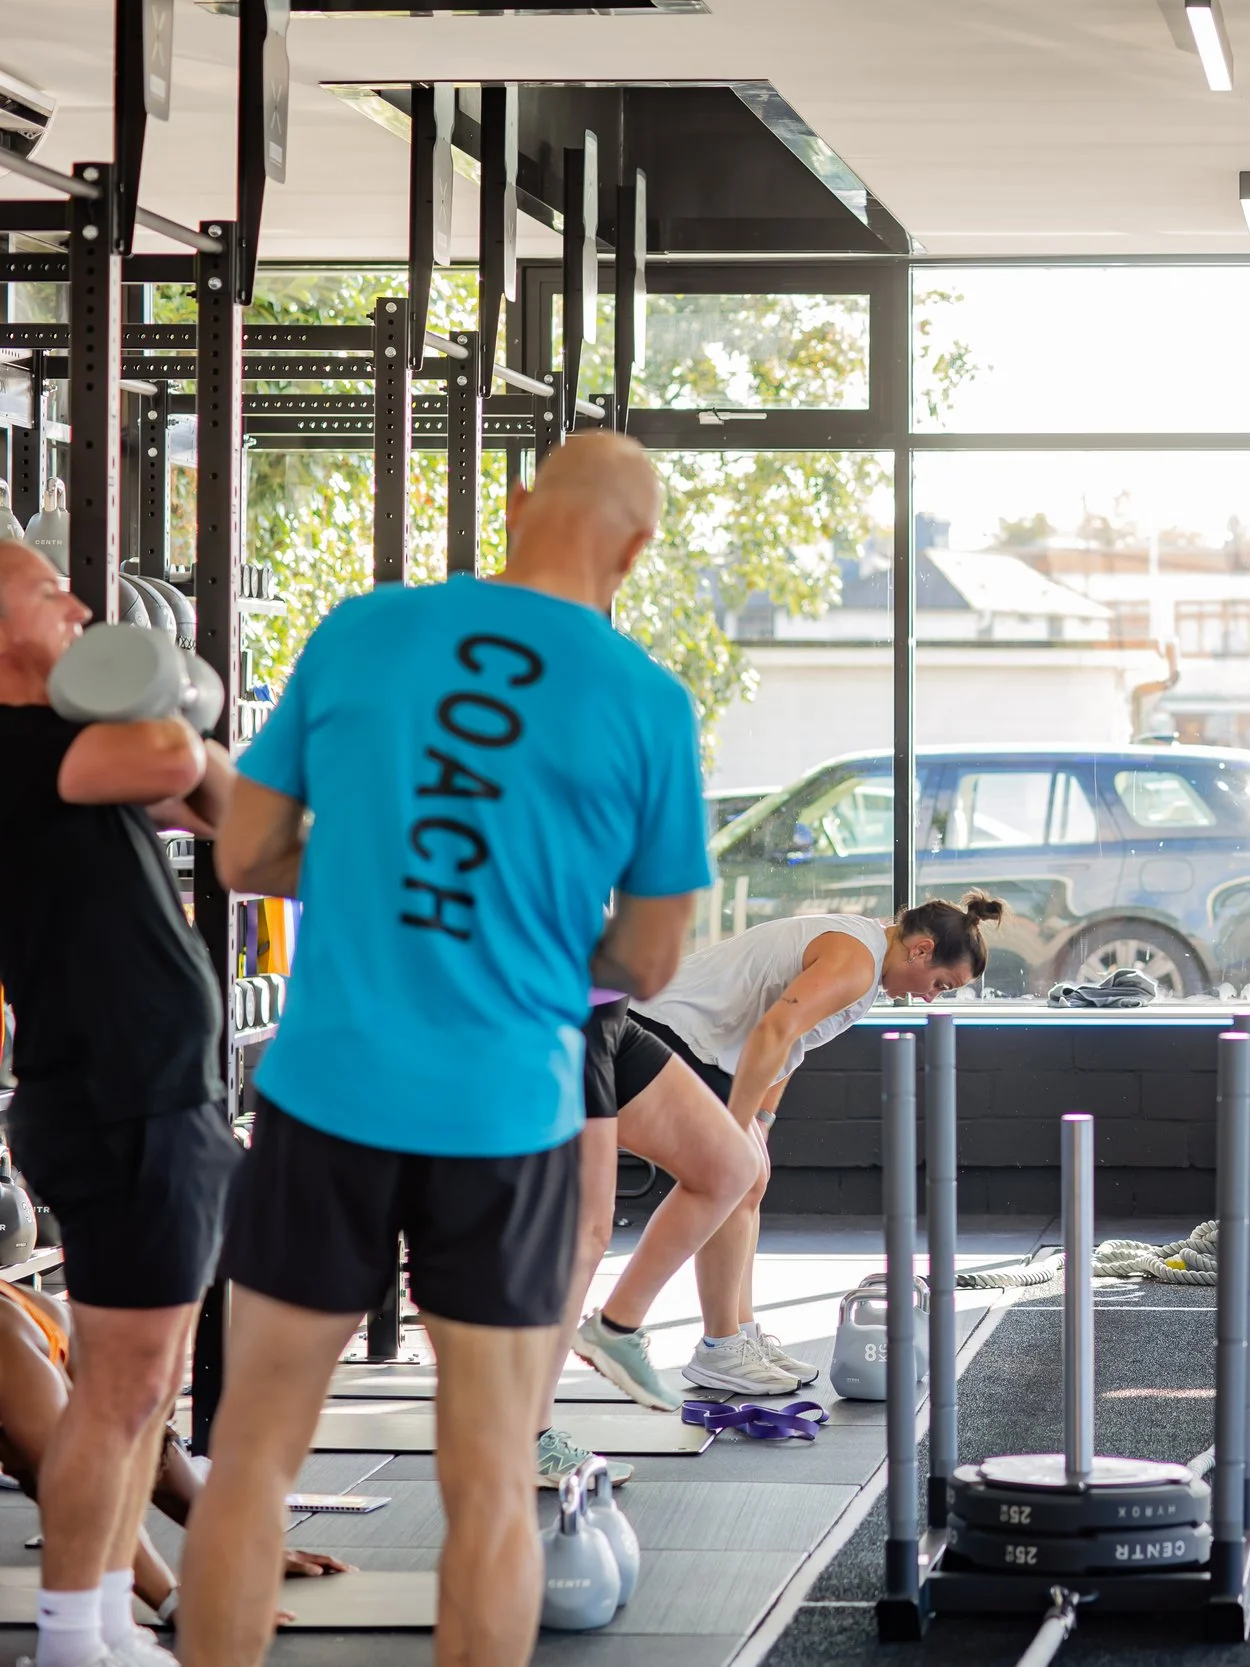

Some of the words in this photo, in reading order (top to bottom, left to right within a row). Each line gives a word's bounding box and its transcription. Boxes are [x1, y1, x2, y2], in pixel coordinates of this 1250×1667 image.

[399, 633, 545, 942] COACH
[864, 1343, 877, 1362] 8
[1009, 1505, 1032, 1525] 25
[1118, 1503, 1177, 1518] HYROX
[1014, 1546, 1038, 1565] 25
[1115, 1540, 1186, 1561] CENTR
